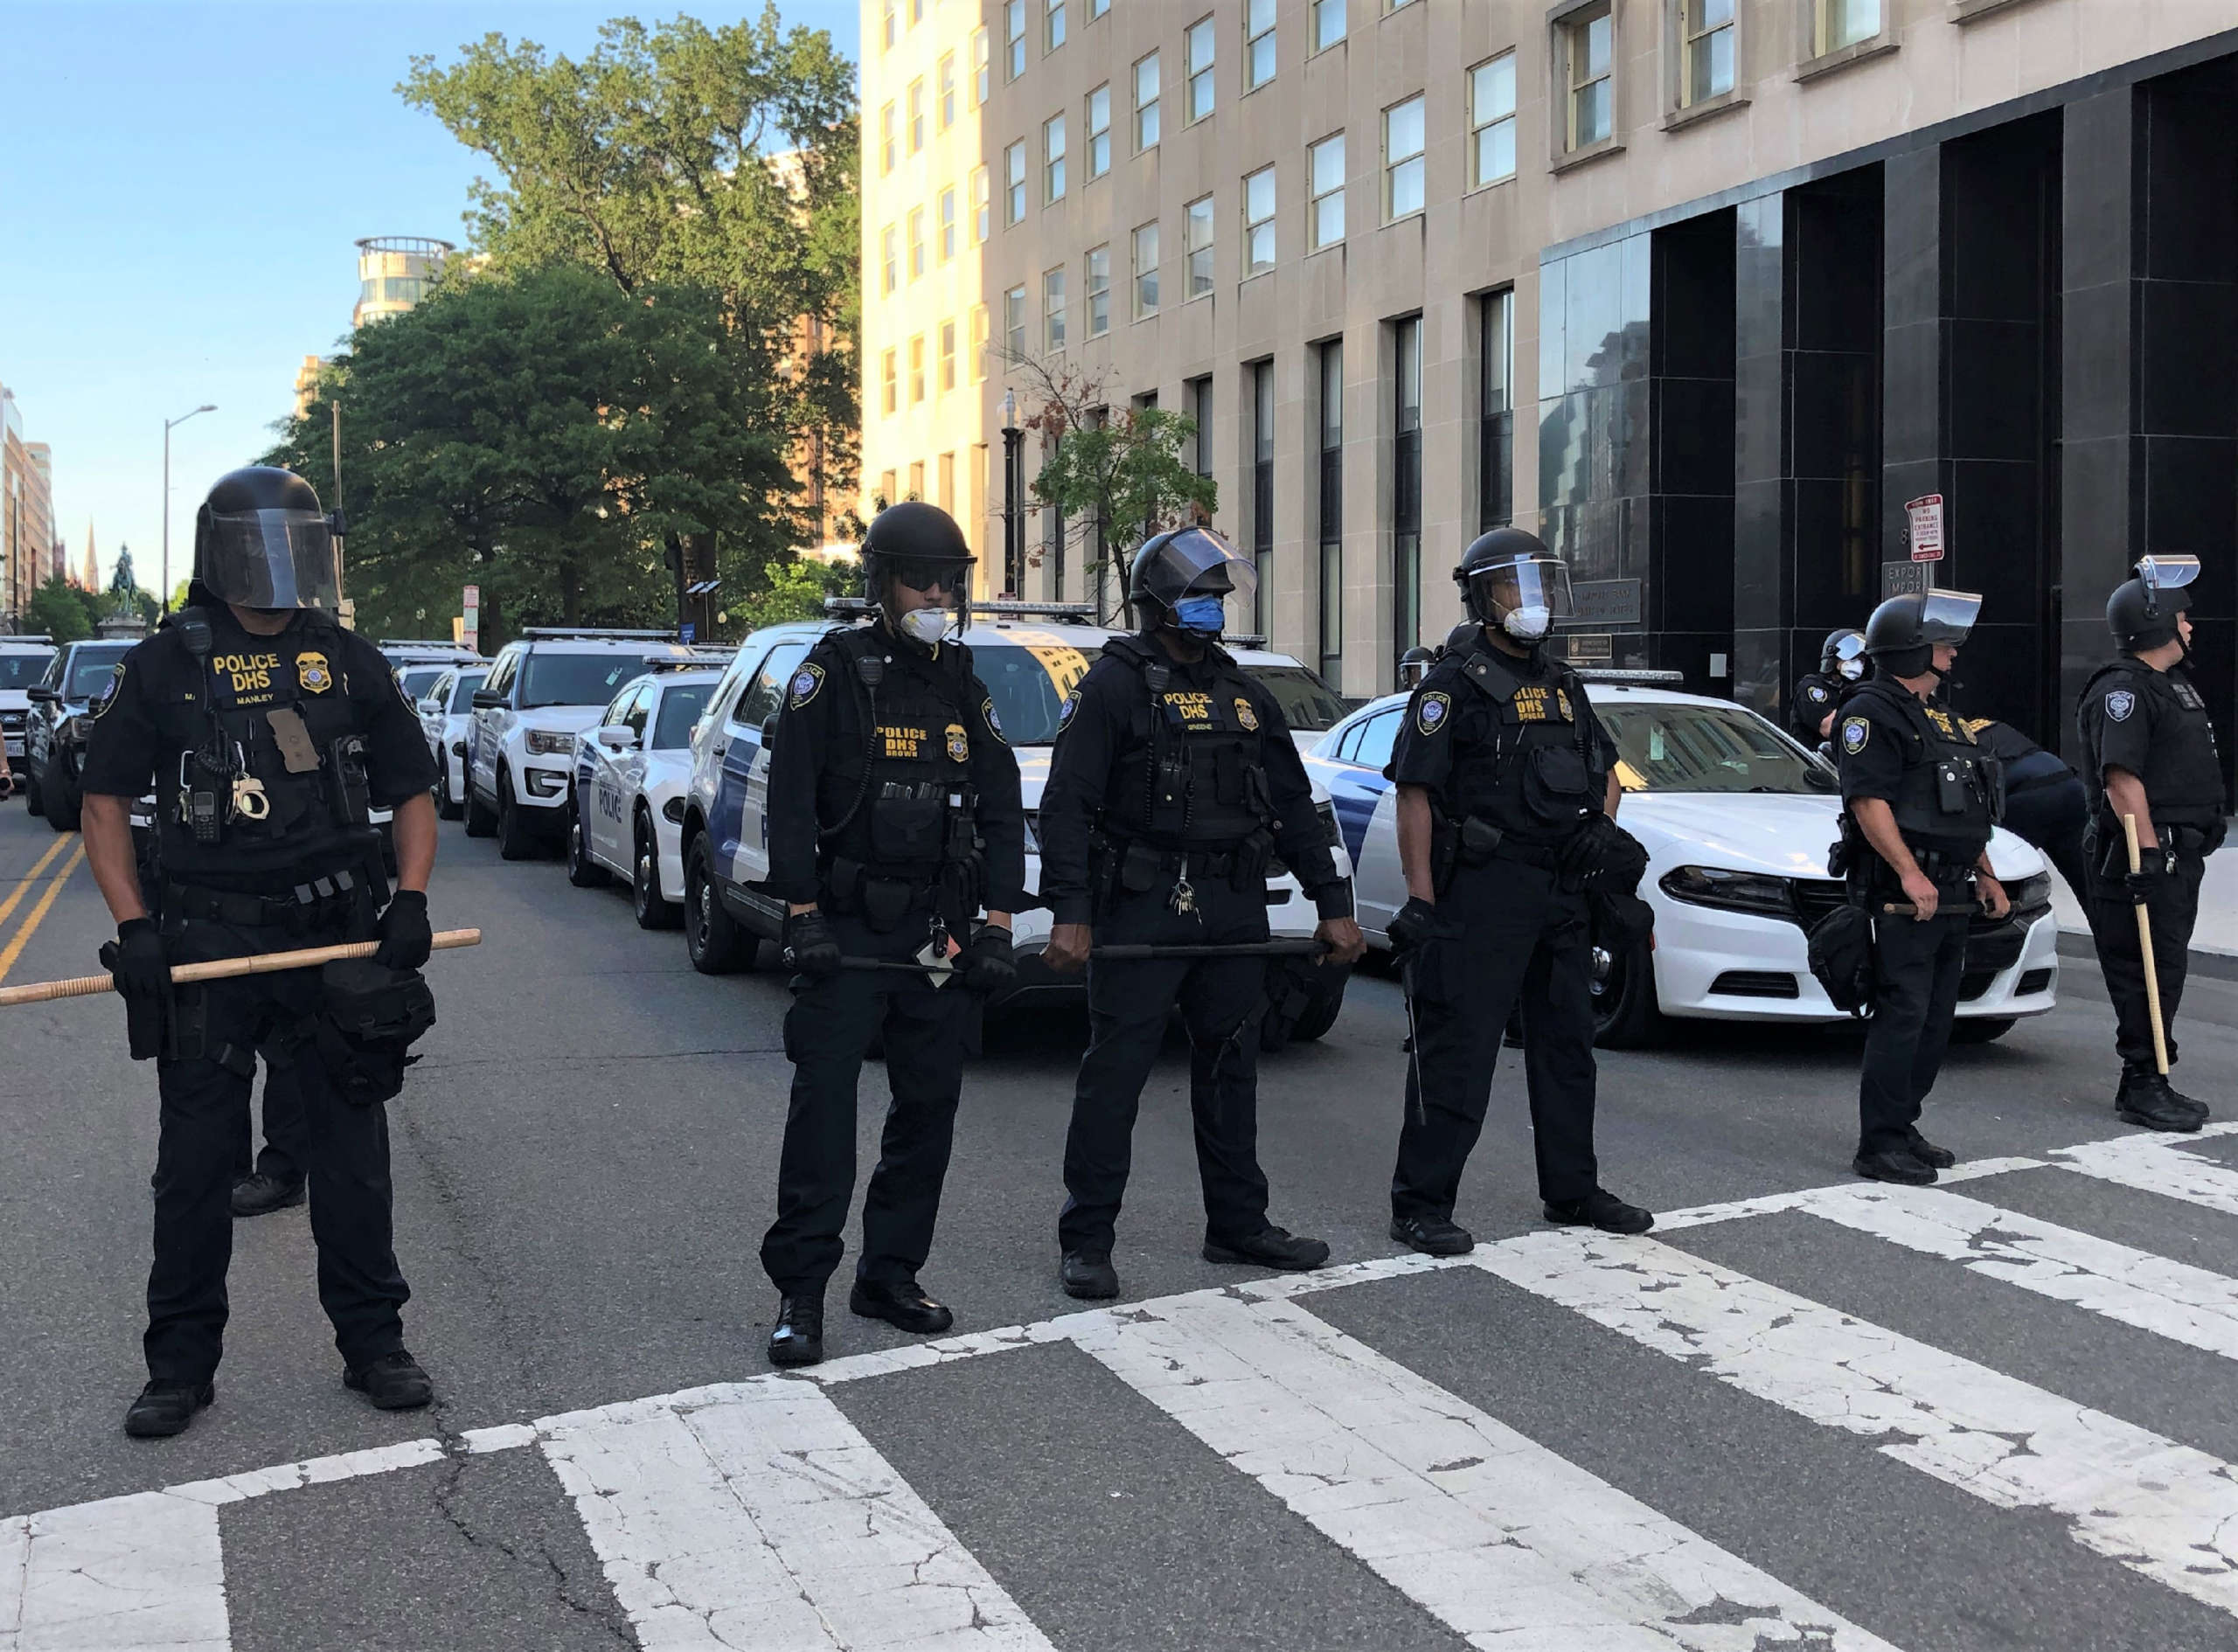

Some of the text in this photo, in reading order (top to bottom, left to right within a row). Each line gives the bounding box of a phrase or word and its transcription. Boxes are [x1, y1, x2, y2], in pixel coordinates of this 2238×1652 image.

[1888, 566, 1922, 580] EXPOR
[1888, 581, 1922, 594] IMPOR
[213, 654, 281, 675] POLICE
[232, 671, 271, 692] DHS
[237, 693, 274, 705] MANLEY
[1164, 692, 1213, 705] POLICE
[1424, 695, 1447, 704] POLICE
[1514, 687, 1548, 700] OLICE
[1179, 705, 1208, 719] DHS
[1516, 699, 1544, 713] DHS
[877, 727, 928, 740] POLICE
[886, 739, 917, 752] DHS
[599, 788, 622, 823] POLIC
